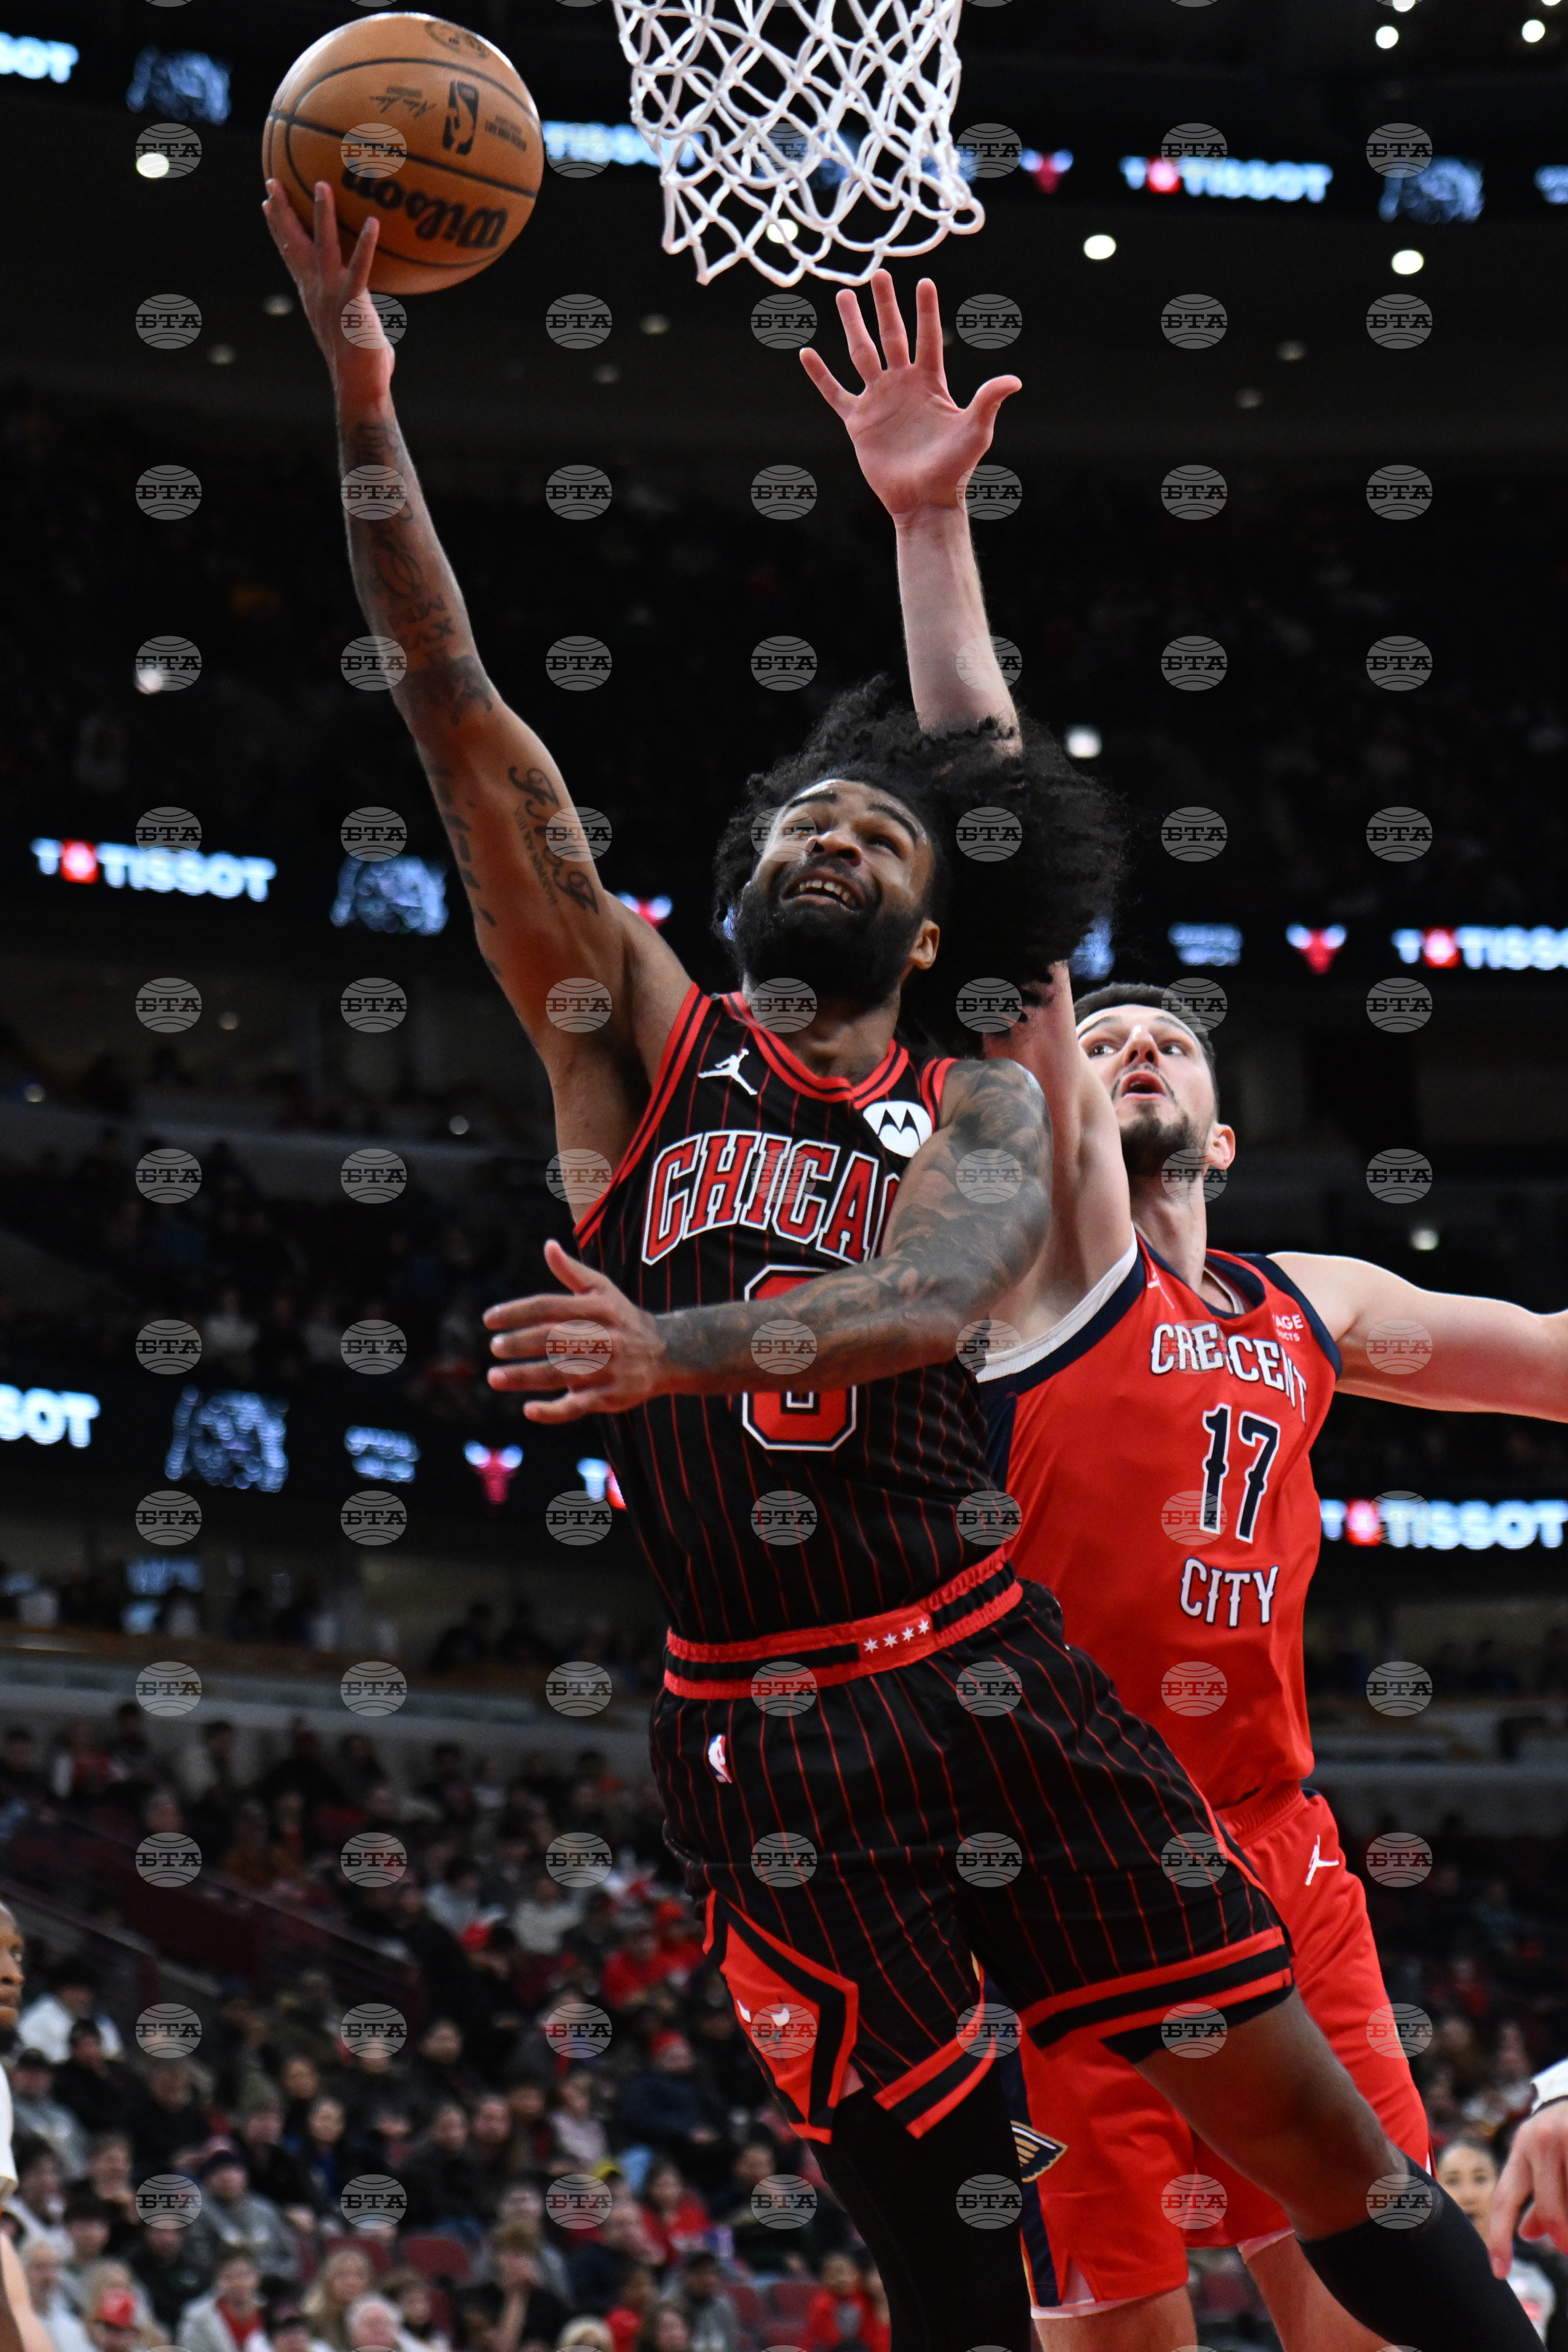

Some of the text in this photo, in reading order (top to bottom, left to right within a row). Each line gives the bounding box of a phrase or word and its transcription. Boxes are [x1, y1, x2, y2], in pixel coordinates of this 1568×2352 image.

[342, 160, 508, 250] Wilson
[97, 841, 277, 903] TISSOT
[1455, 924, 1568, 970] TISS
[642, 1129, 901, 1266] CHICA
[1272, 1314, 1304, 1330] AGE
[1150, 1322, 1307, 1424] CRECENT
[1199, 1402, 1281, 1544] 17
[1379, 1498, 1568, 1550] TISSOT
[1180, 1557, 1279, 1628] CITY
